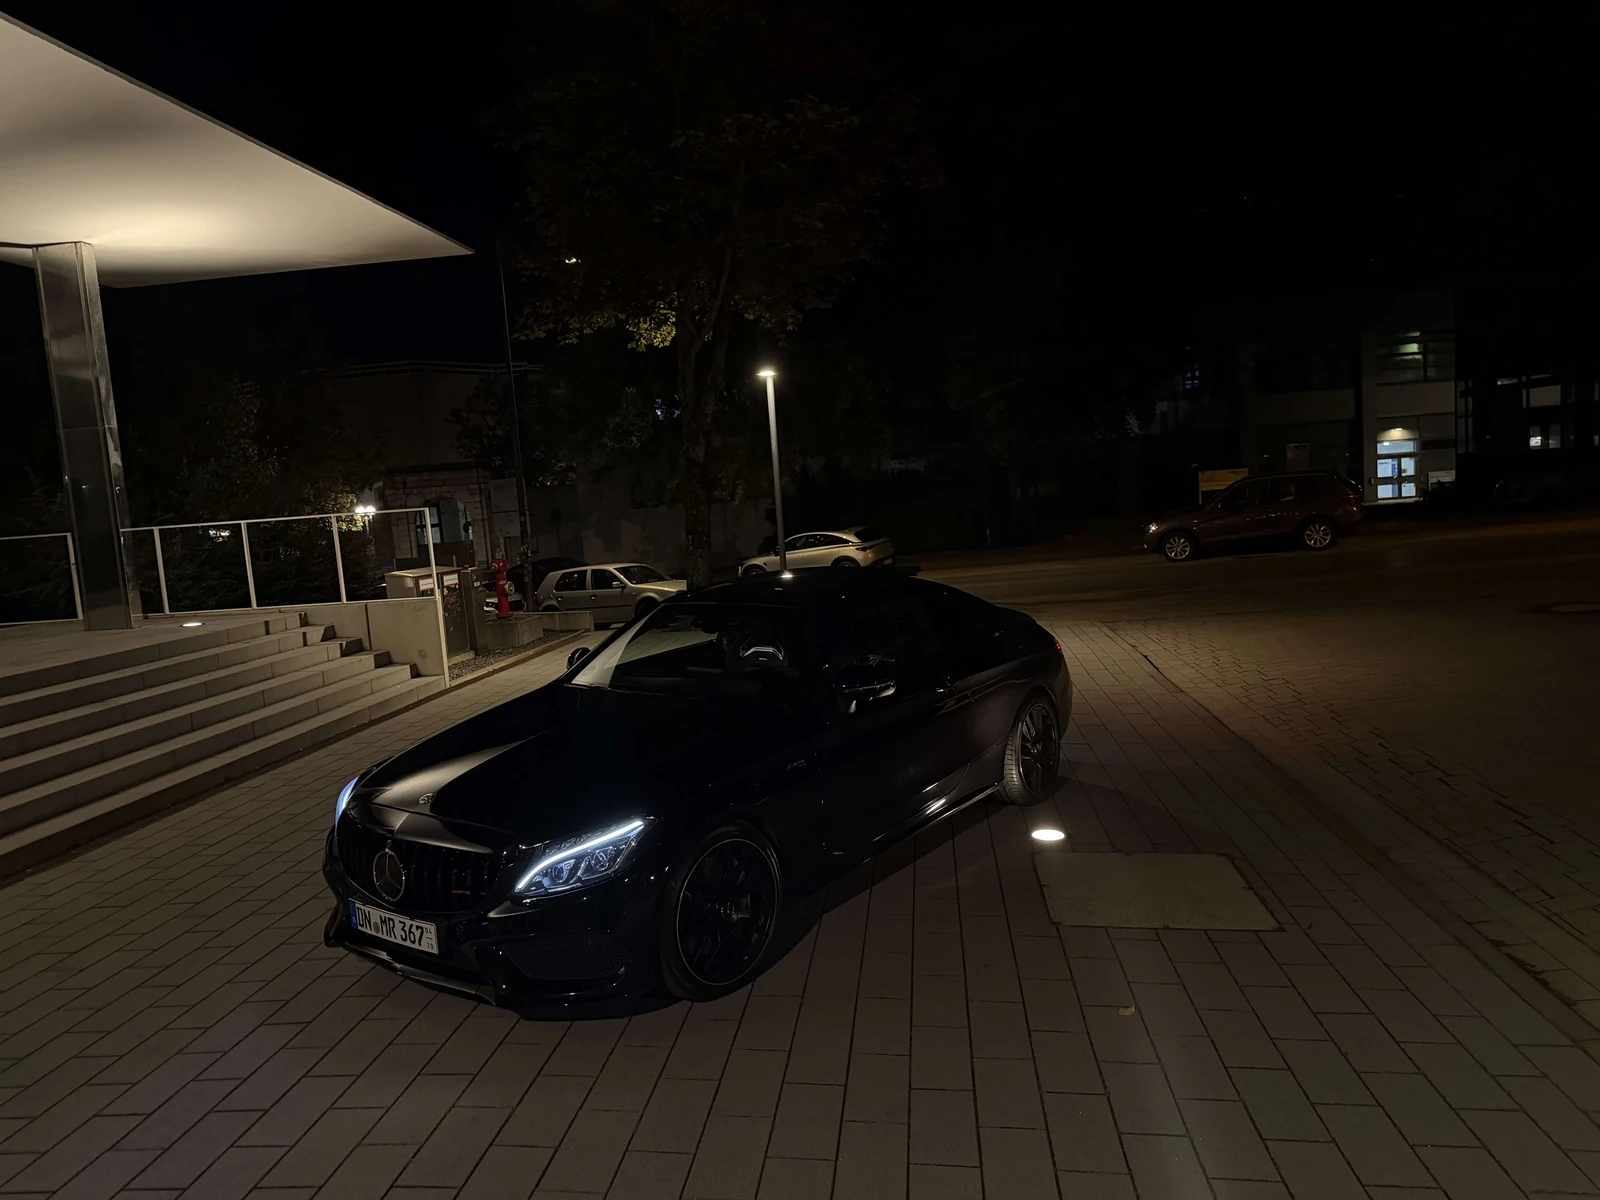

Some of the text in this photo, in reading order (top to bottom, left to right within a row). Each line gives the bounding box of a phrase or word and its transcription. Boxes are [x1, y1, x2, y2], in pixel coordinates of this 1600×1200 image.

[357, 907, 424, 947] DN MR 367
